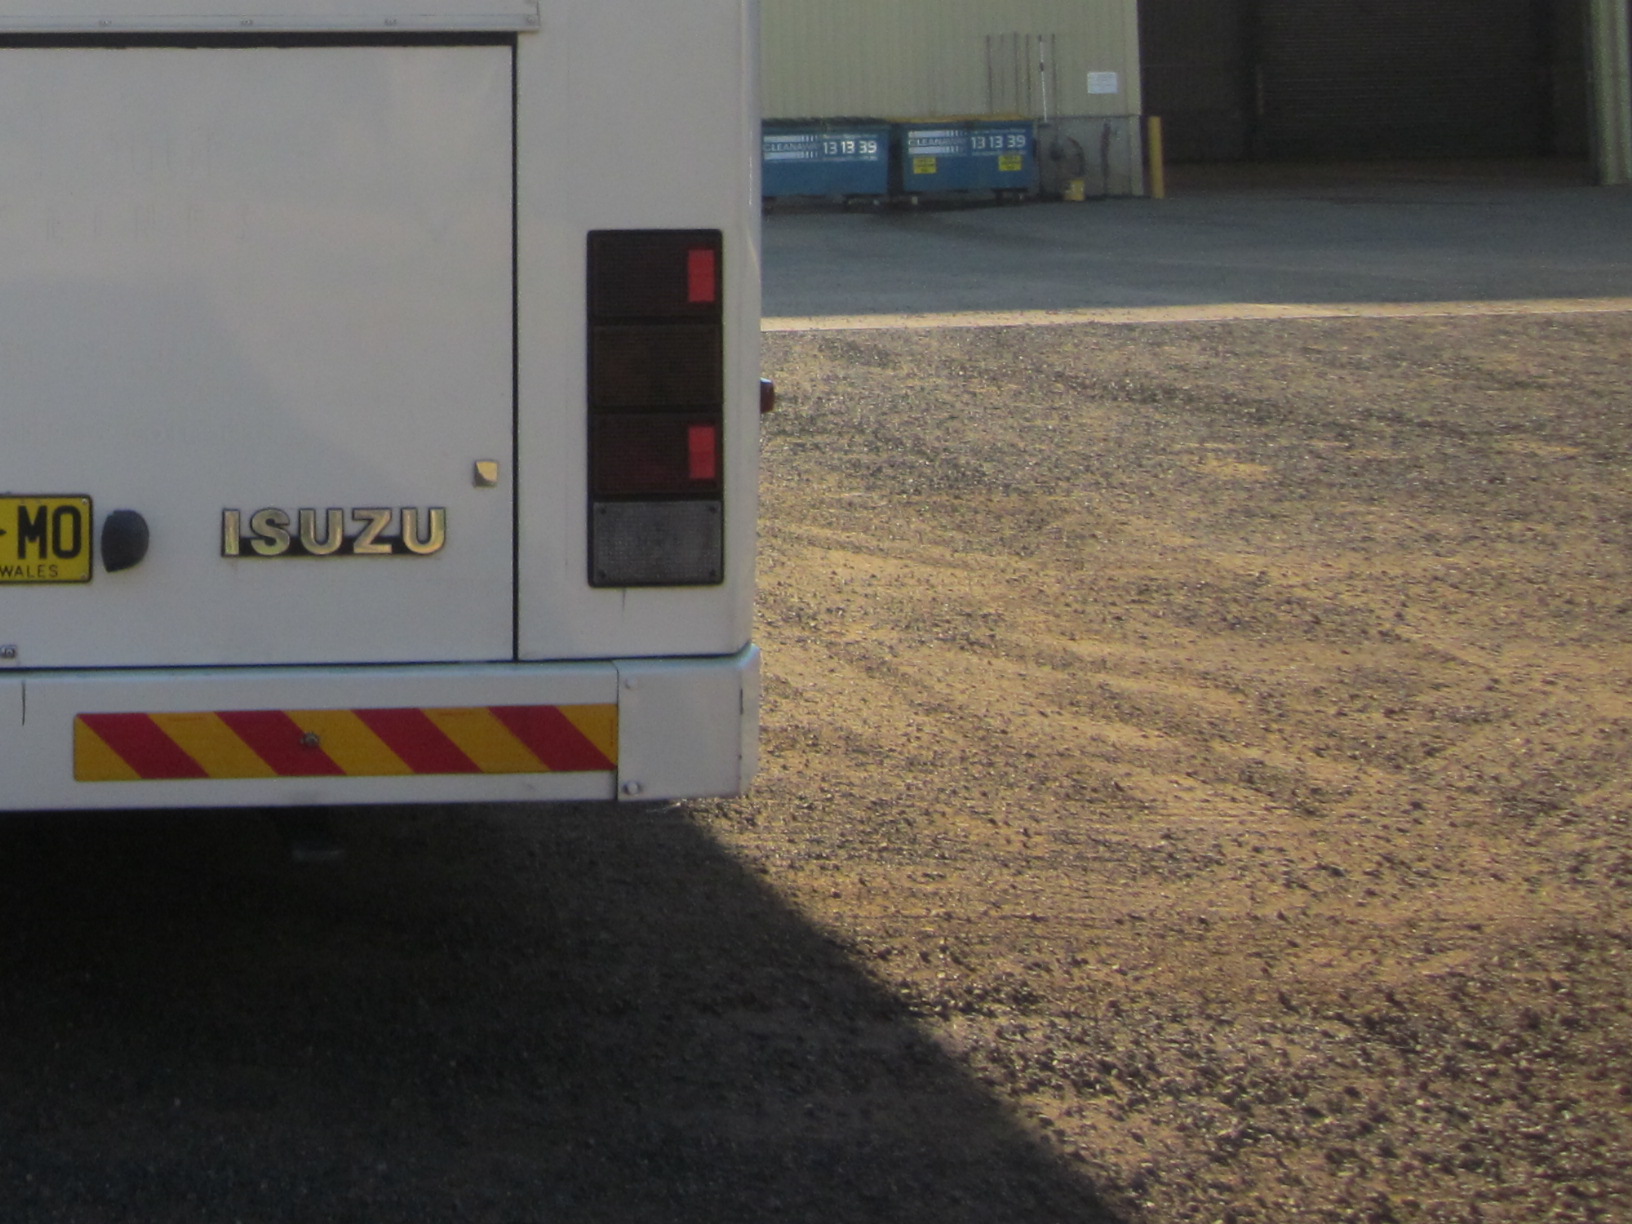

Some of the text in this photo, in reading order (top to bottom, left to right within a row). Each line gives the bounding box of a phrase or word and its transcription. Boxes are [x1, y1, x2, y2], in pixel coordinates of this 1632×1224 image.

[822, 142, 838, 155] 13
[840, 141, 855, 154] 13
[858, 140, 878, 154] 39
[971, 136, 986, 150] 13
[989, 135, 1003, 149] 13
[1006, 134, 1026, 149] 39
[221, 506, 447, 558] ISUZU
